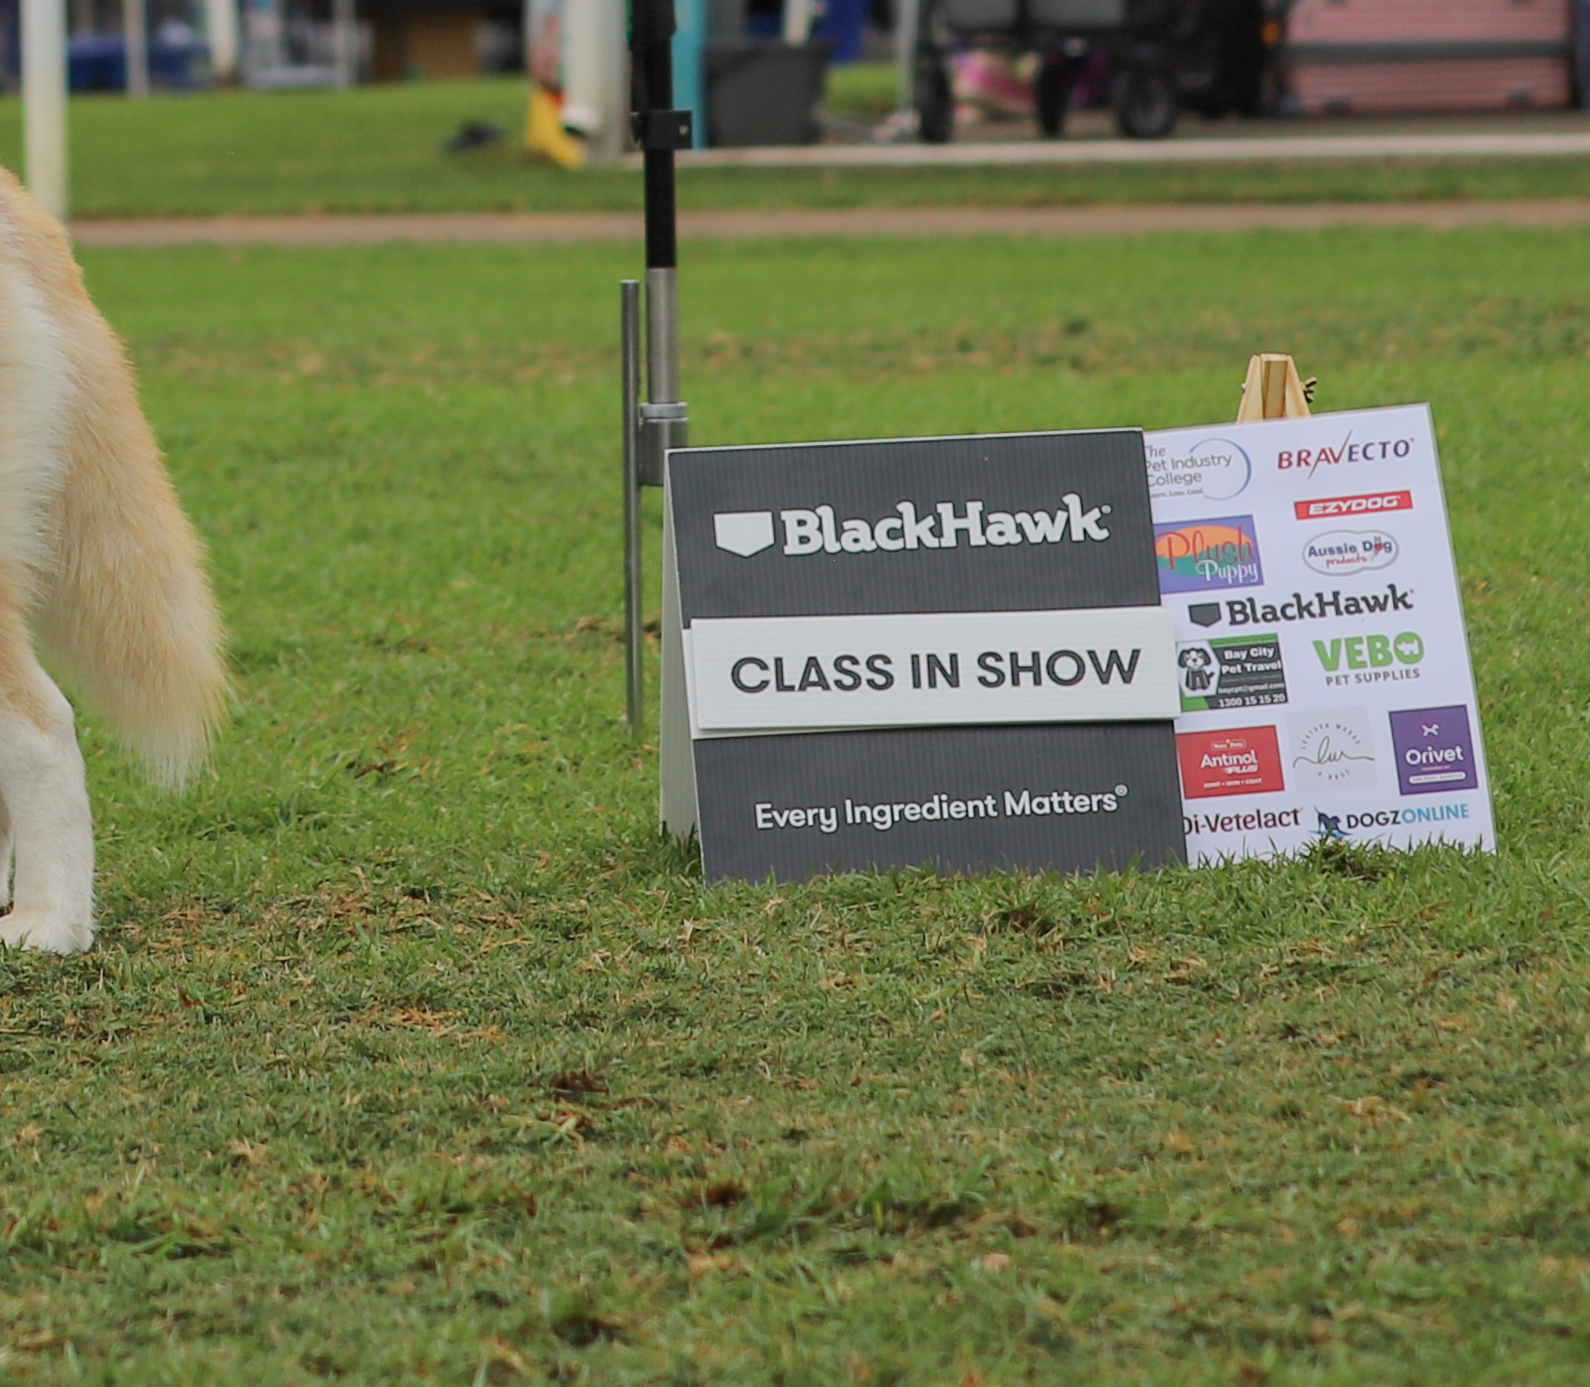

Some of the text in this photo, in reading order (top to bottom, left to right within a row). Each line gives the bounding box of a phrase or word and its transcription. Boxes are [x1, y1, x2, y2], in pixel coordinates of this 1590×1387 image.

[1171, 454, 1232, 470] Industry
[1277, 429, 1410, 479] BRAVECTO
[1308, 495, 1399, 516] EZYDOG
[1154, 525, 1254, 570] Plush
[1308, 542, 1357, 558] Aussie
[1326, 554, 1368, 569] products
[1196, 559, 1259, 585] Puppy
[1224, 646, 1275, 661] Bay City
[1312, 631, 1425, 672] VEBO
[731, 648, 1142, 693] CLASS IN SHOW
[1222, 661, 1282, 674] Pet Travel
[1326, 668, 1421, 687] PET SUPPLIES
[1218, 693, 1286, 707] 1300 15 15 20
[1200, 748, 1259, 768] Antinol
[1405, 745, 1465, 766] Orivet
[1228, 764, 1259, 775] PLUS
[755, 802, 837, 833] Every
[845, 792, 999, 830] Ingredient
[1346, 803, 1470, 829] DOGZONLINE
